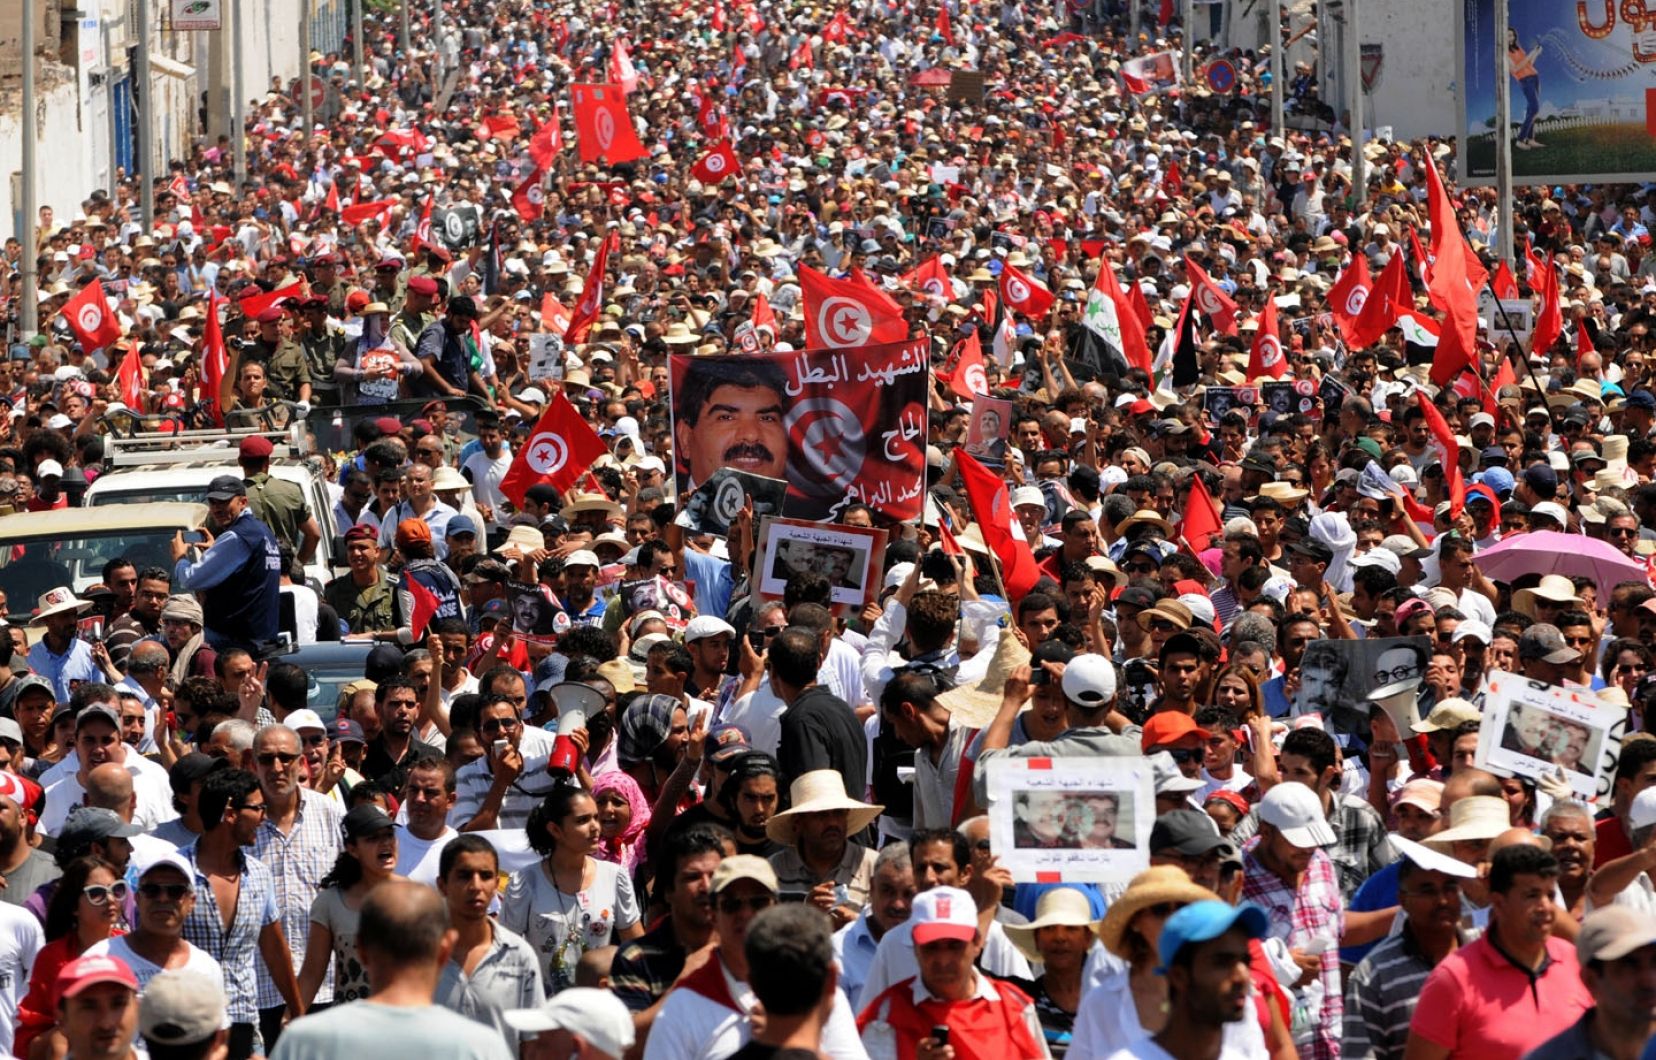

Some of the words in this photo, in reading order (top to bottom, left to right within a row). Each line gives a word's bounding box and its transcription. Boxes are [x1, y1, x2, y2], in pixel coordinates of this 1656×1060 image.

[784, 353, 849, 397] البطل
[857, 345, 928, 388] الشهيد
[882, 411, 922, 461] الحاج
